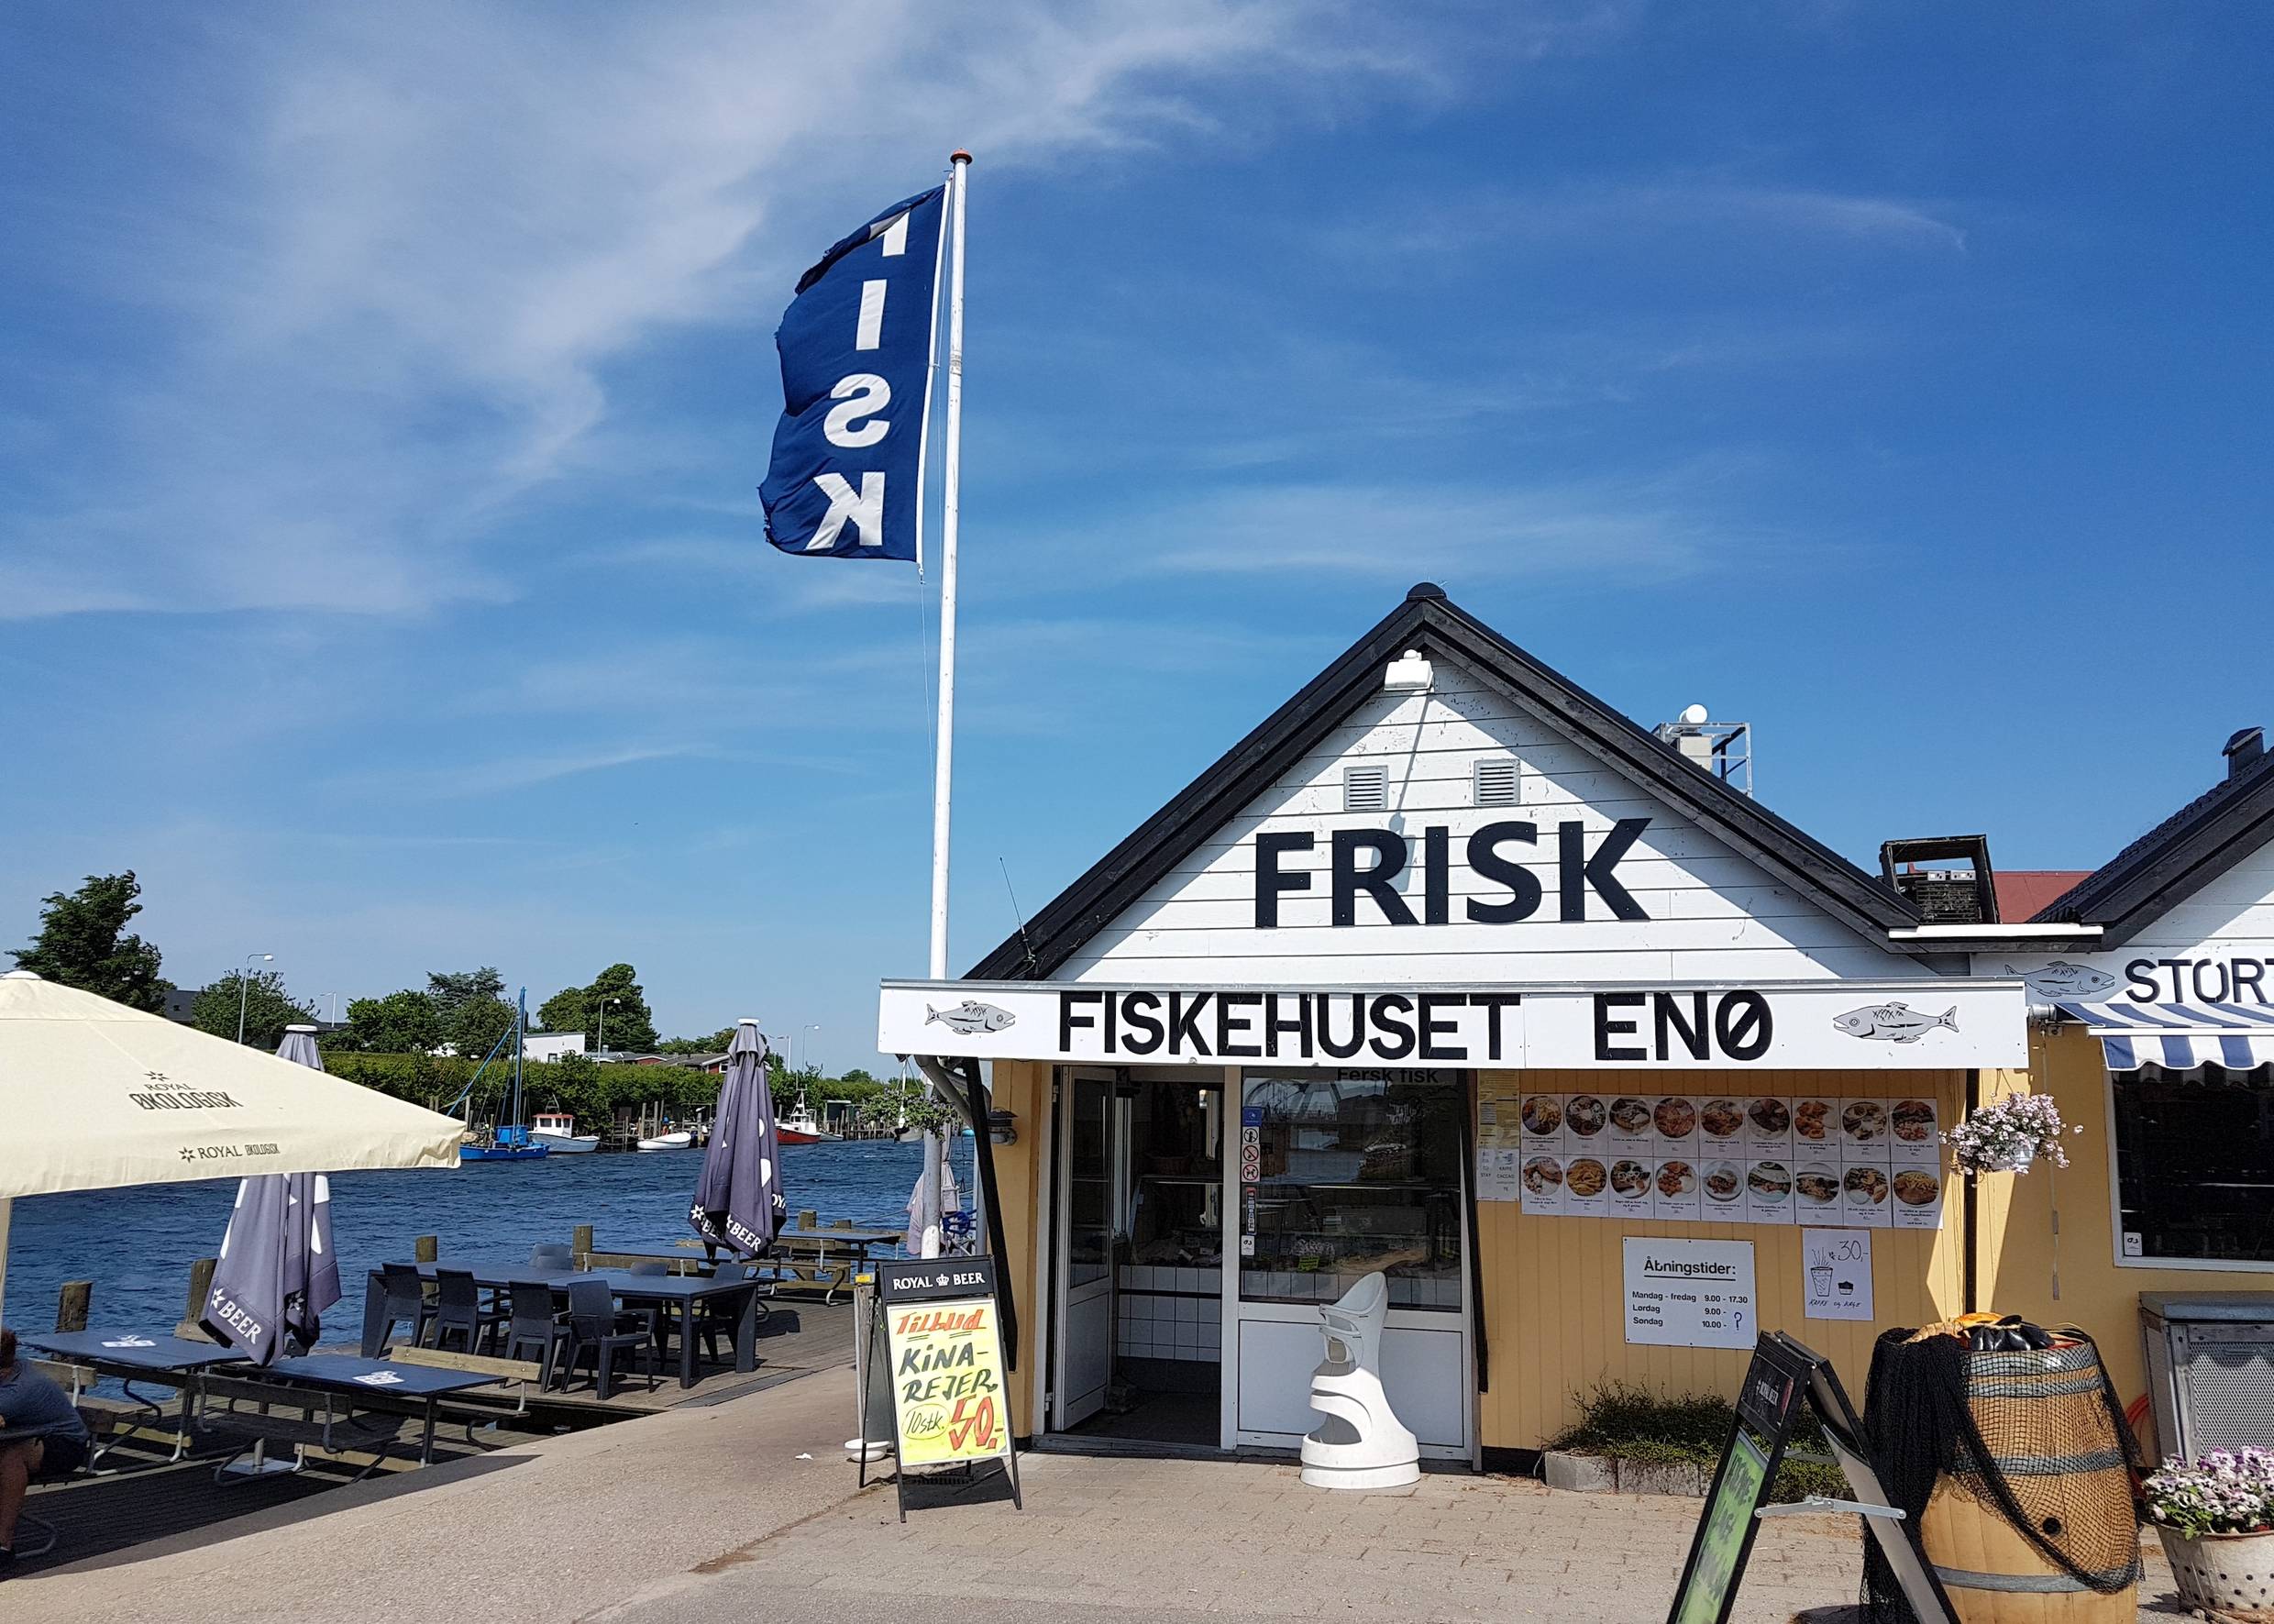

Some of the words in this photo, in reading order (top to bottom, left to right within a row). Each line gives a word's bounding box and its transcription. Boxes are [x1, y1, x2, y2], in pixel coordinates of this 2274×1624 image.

[1255, 817, 1653, 928] FRISK
[2125, 957, 2274, 1004] STOR
[1059, 990, 1520, 1060] FISKEHUSET
[1594, 989, 1773, 1061] ENØ
[1400, 1067, 1438, 1084] fisk
[144, 1083, 197, 1091] ROYAL
[129, 1091, 244, 1110] ØKOLOGISK
[197, 1145, 243, 1159] ROYAL
[245, 1143, 281, 1156] ØKOLOGISK
[729, 1221, 762, 1252] BEER
[1644, 1255, 1736, 1276] Åbningstider:
[892, 1276, 933, 1290] ROYAL
[953, 1272, 986, 1286] BEER
[1632, 1290, 1663, 1300] Mandag
[1671, 1292, 1696, 1302] fredag
[1705, 1294, 1721, 1303] 9.00
[1728, 1296, 1749, 1304] 17.30
[1705, 1307, 1721, 1316] 9.00
[217, 1300, 262, 1344] BEER
[1702, 1320, 1722, 1329] 10.00
